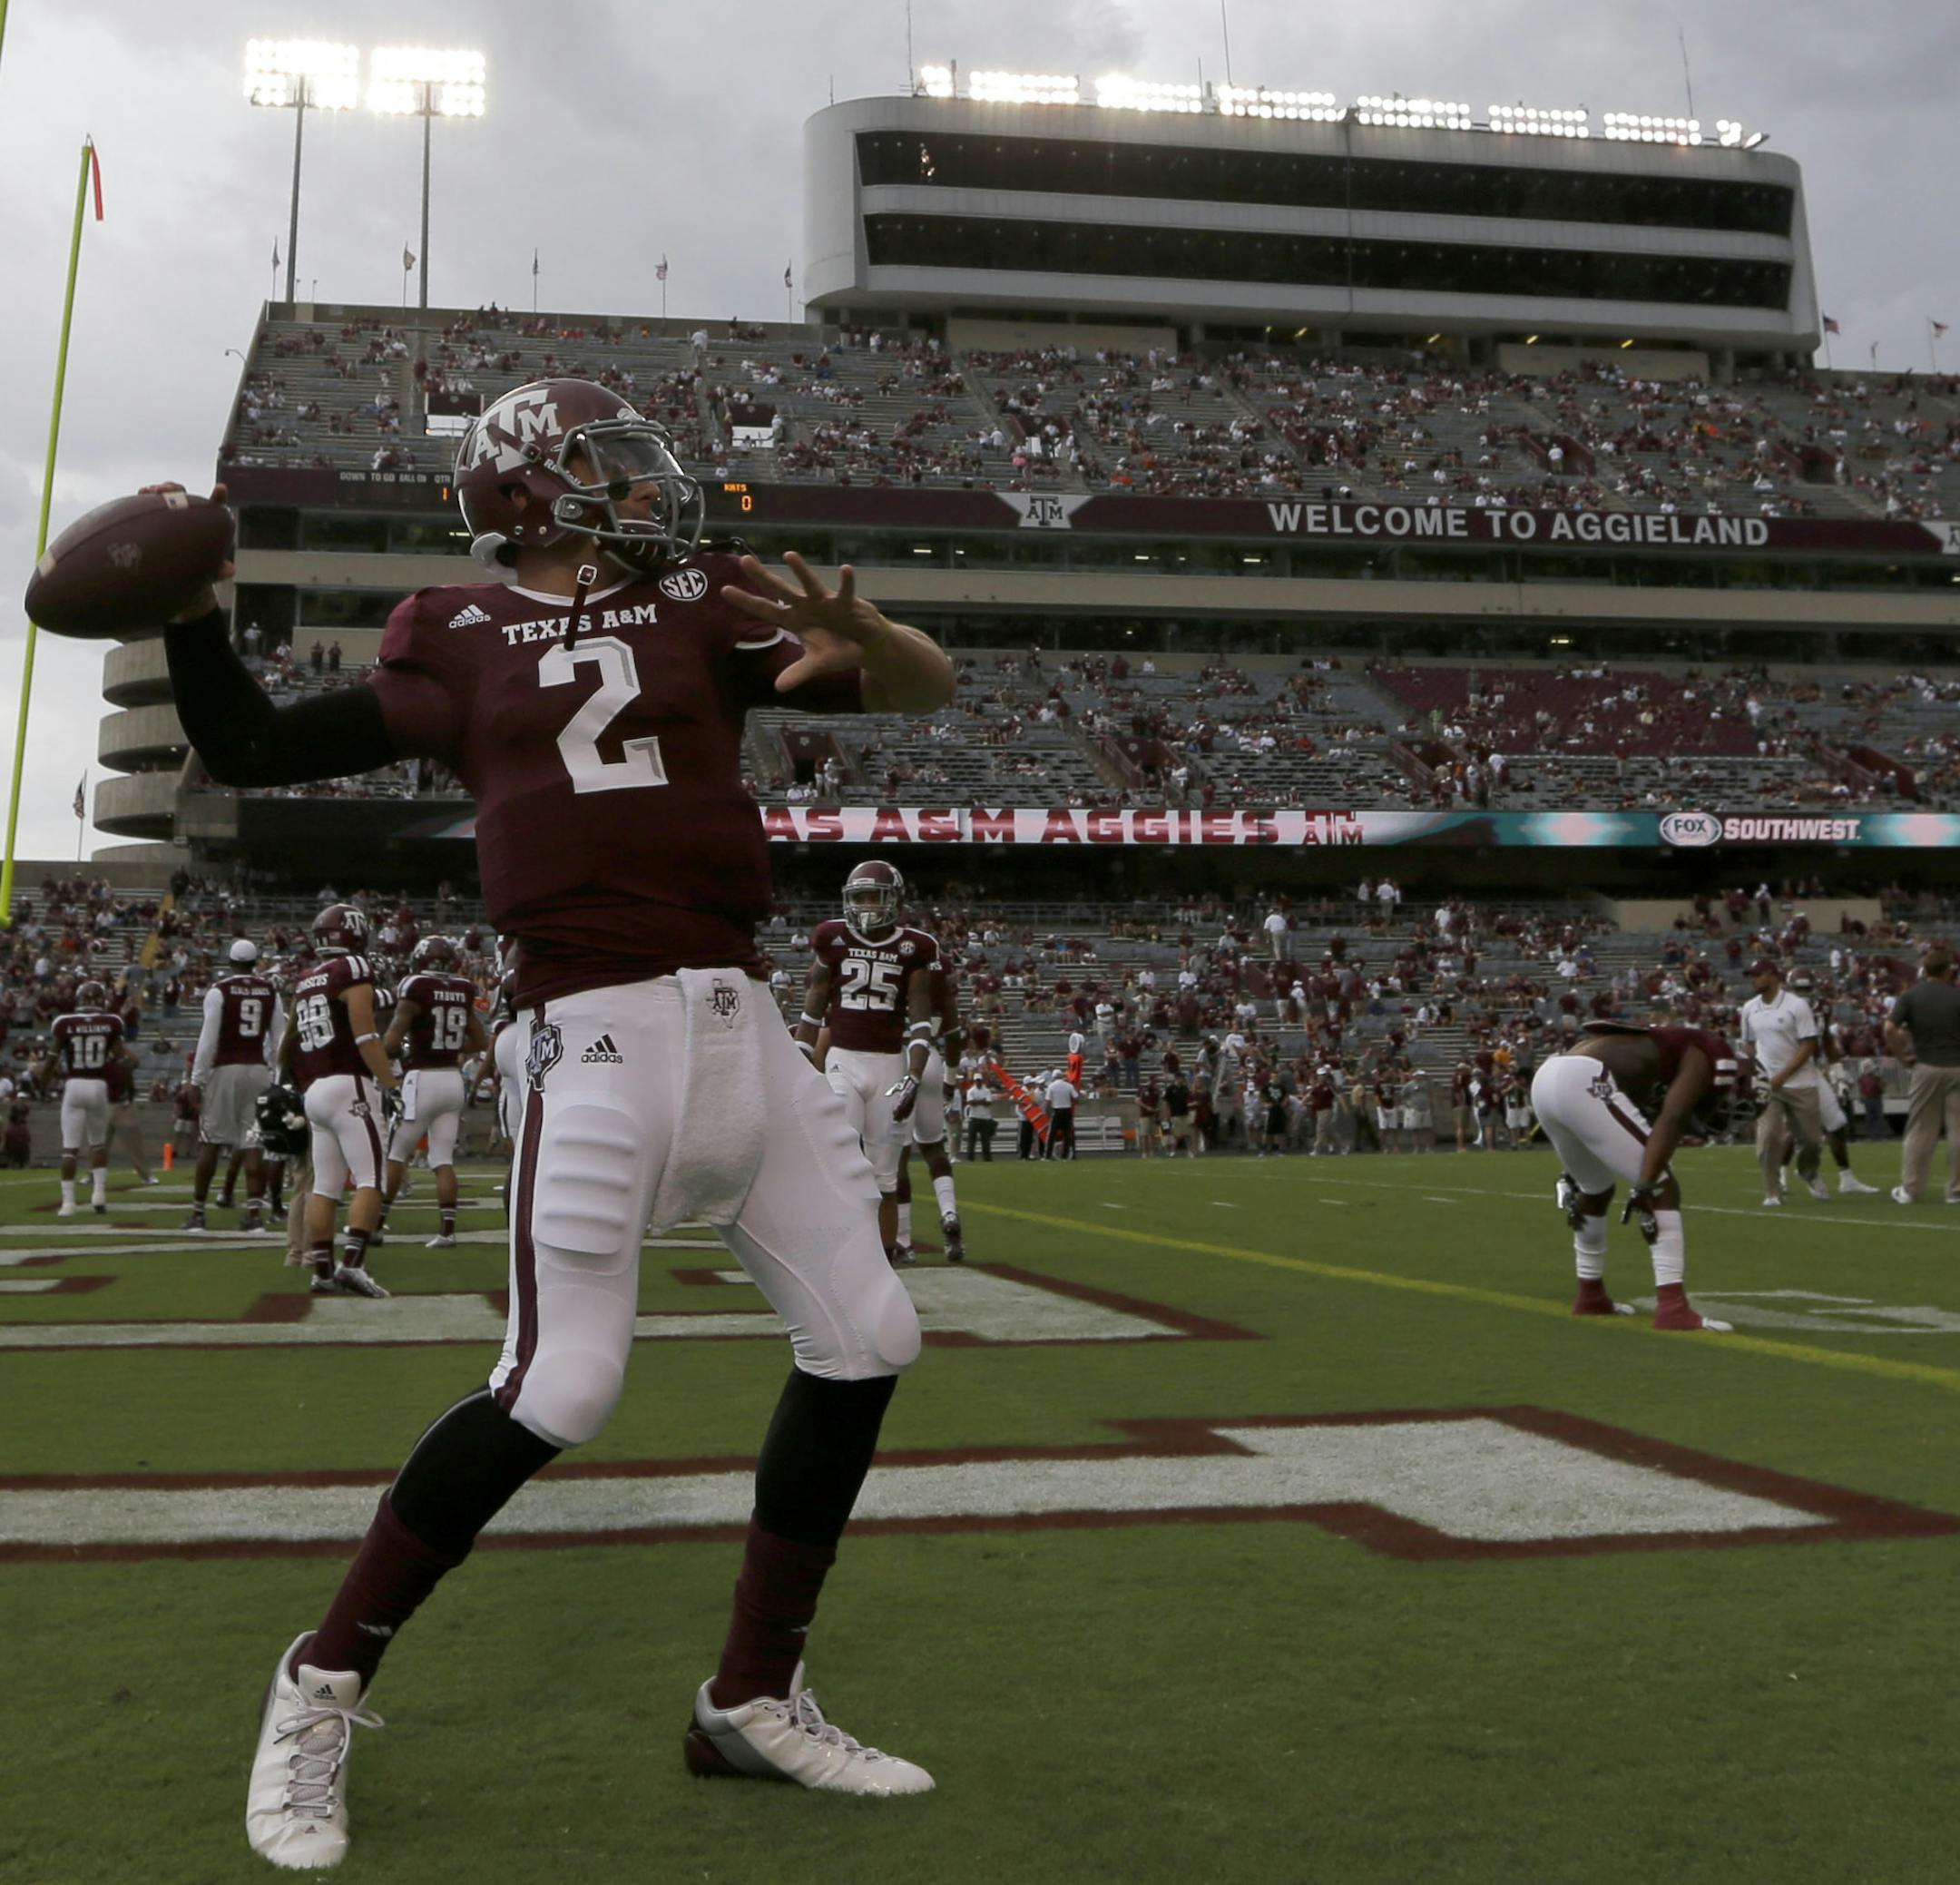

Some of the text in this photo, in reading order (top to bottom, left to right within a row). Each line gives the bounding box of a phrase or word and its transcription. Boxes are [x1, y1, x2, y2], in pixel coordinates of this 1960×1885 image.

[339, 472, 366, 481] DOWN
[370, 472, 380, 482] TO
[741, 495, 751, 511] 0
[1026, 496, 1063, 526] ATM
[1266, 502, 1770, 547] WELCOME TO AGGIELAND
[662, 571, 704, 598] SEC
[448, 614, 492, 630] adidas
[602, 603, 658, 629] A&M
[538, 636, 670, 794] 2
[868, 807, 1015, 842] A&M
[1041, 808, 1278, 844] AGGIES
[1674, 819, 1707, 833] FOX
[848, 947, 877, 959] TEXAS
[840, 957, 904, 1011] 25
[239, 998, 262, 1036] 9
[431, 1006, 467, 1050] 19
[70, 1036, 107, 1069] 10
[581, 1052, 623, 1064] adidas
